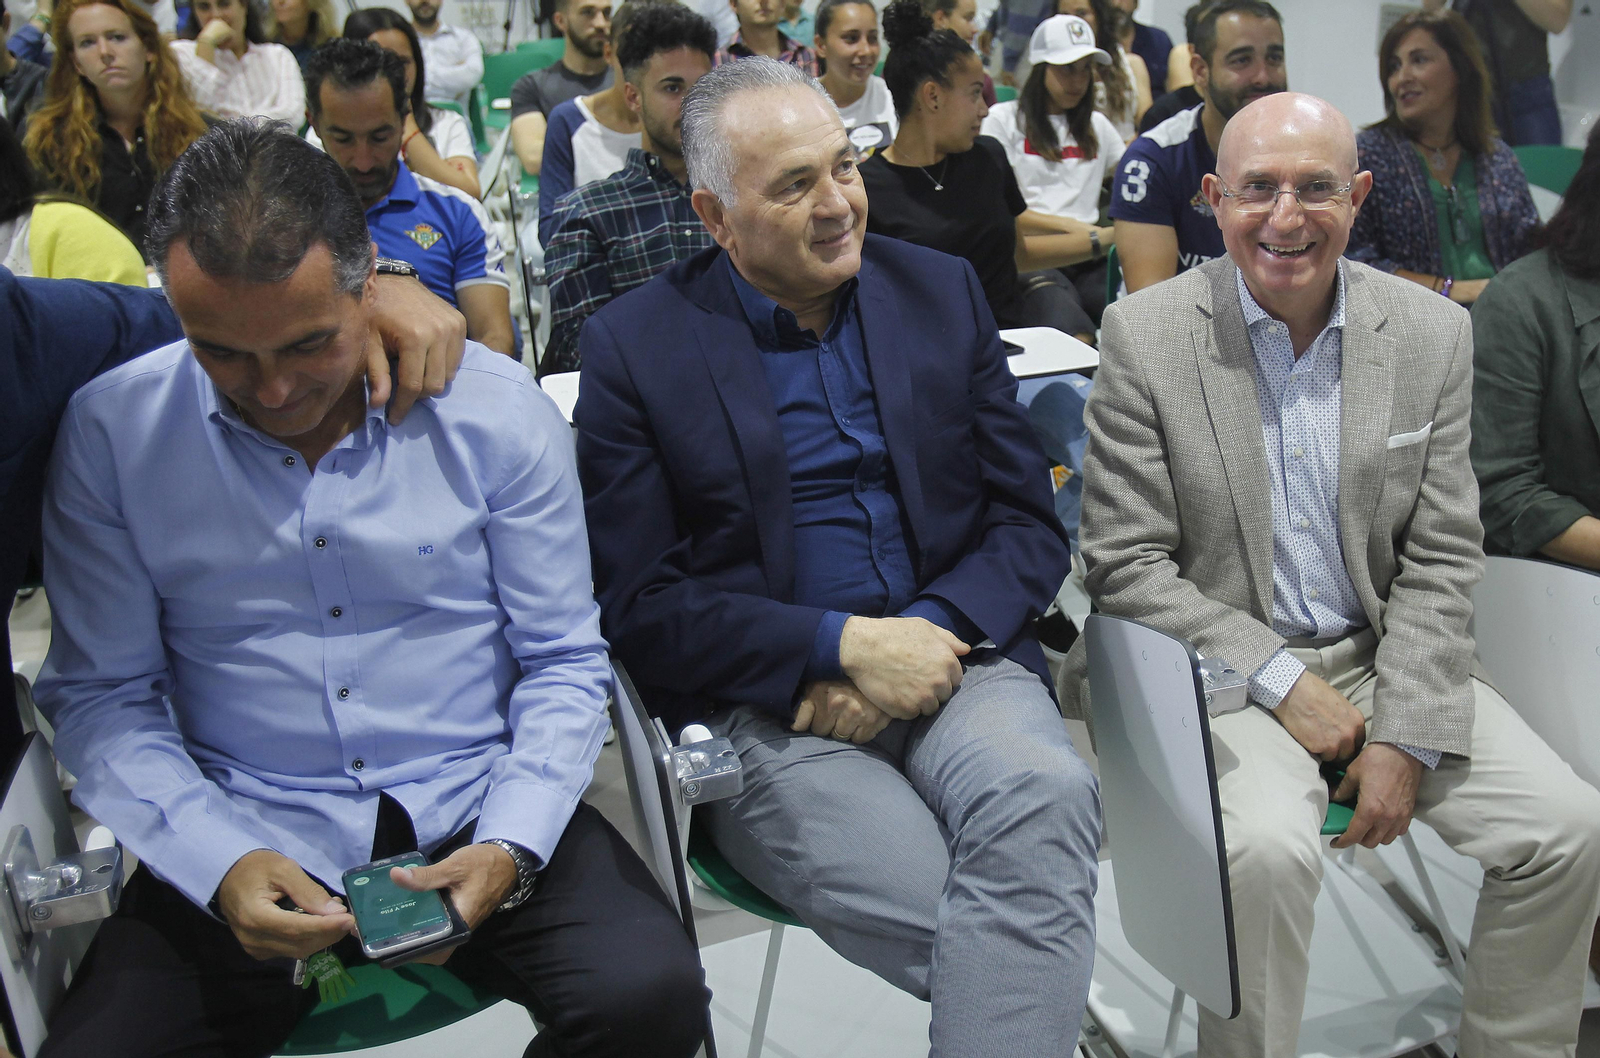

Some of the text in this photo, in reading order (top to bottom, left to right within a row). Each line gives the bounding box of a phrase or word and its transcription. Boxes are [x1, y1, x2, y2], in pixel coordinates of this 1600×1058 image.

[1121, 160, 1150, 203] 3
[418, 545, 434, 555] HG
[319, 965, 341, 982] Mano
